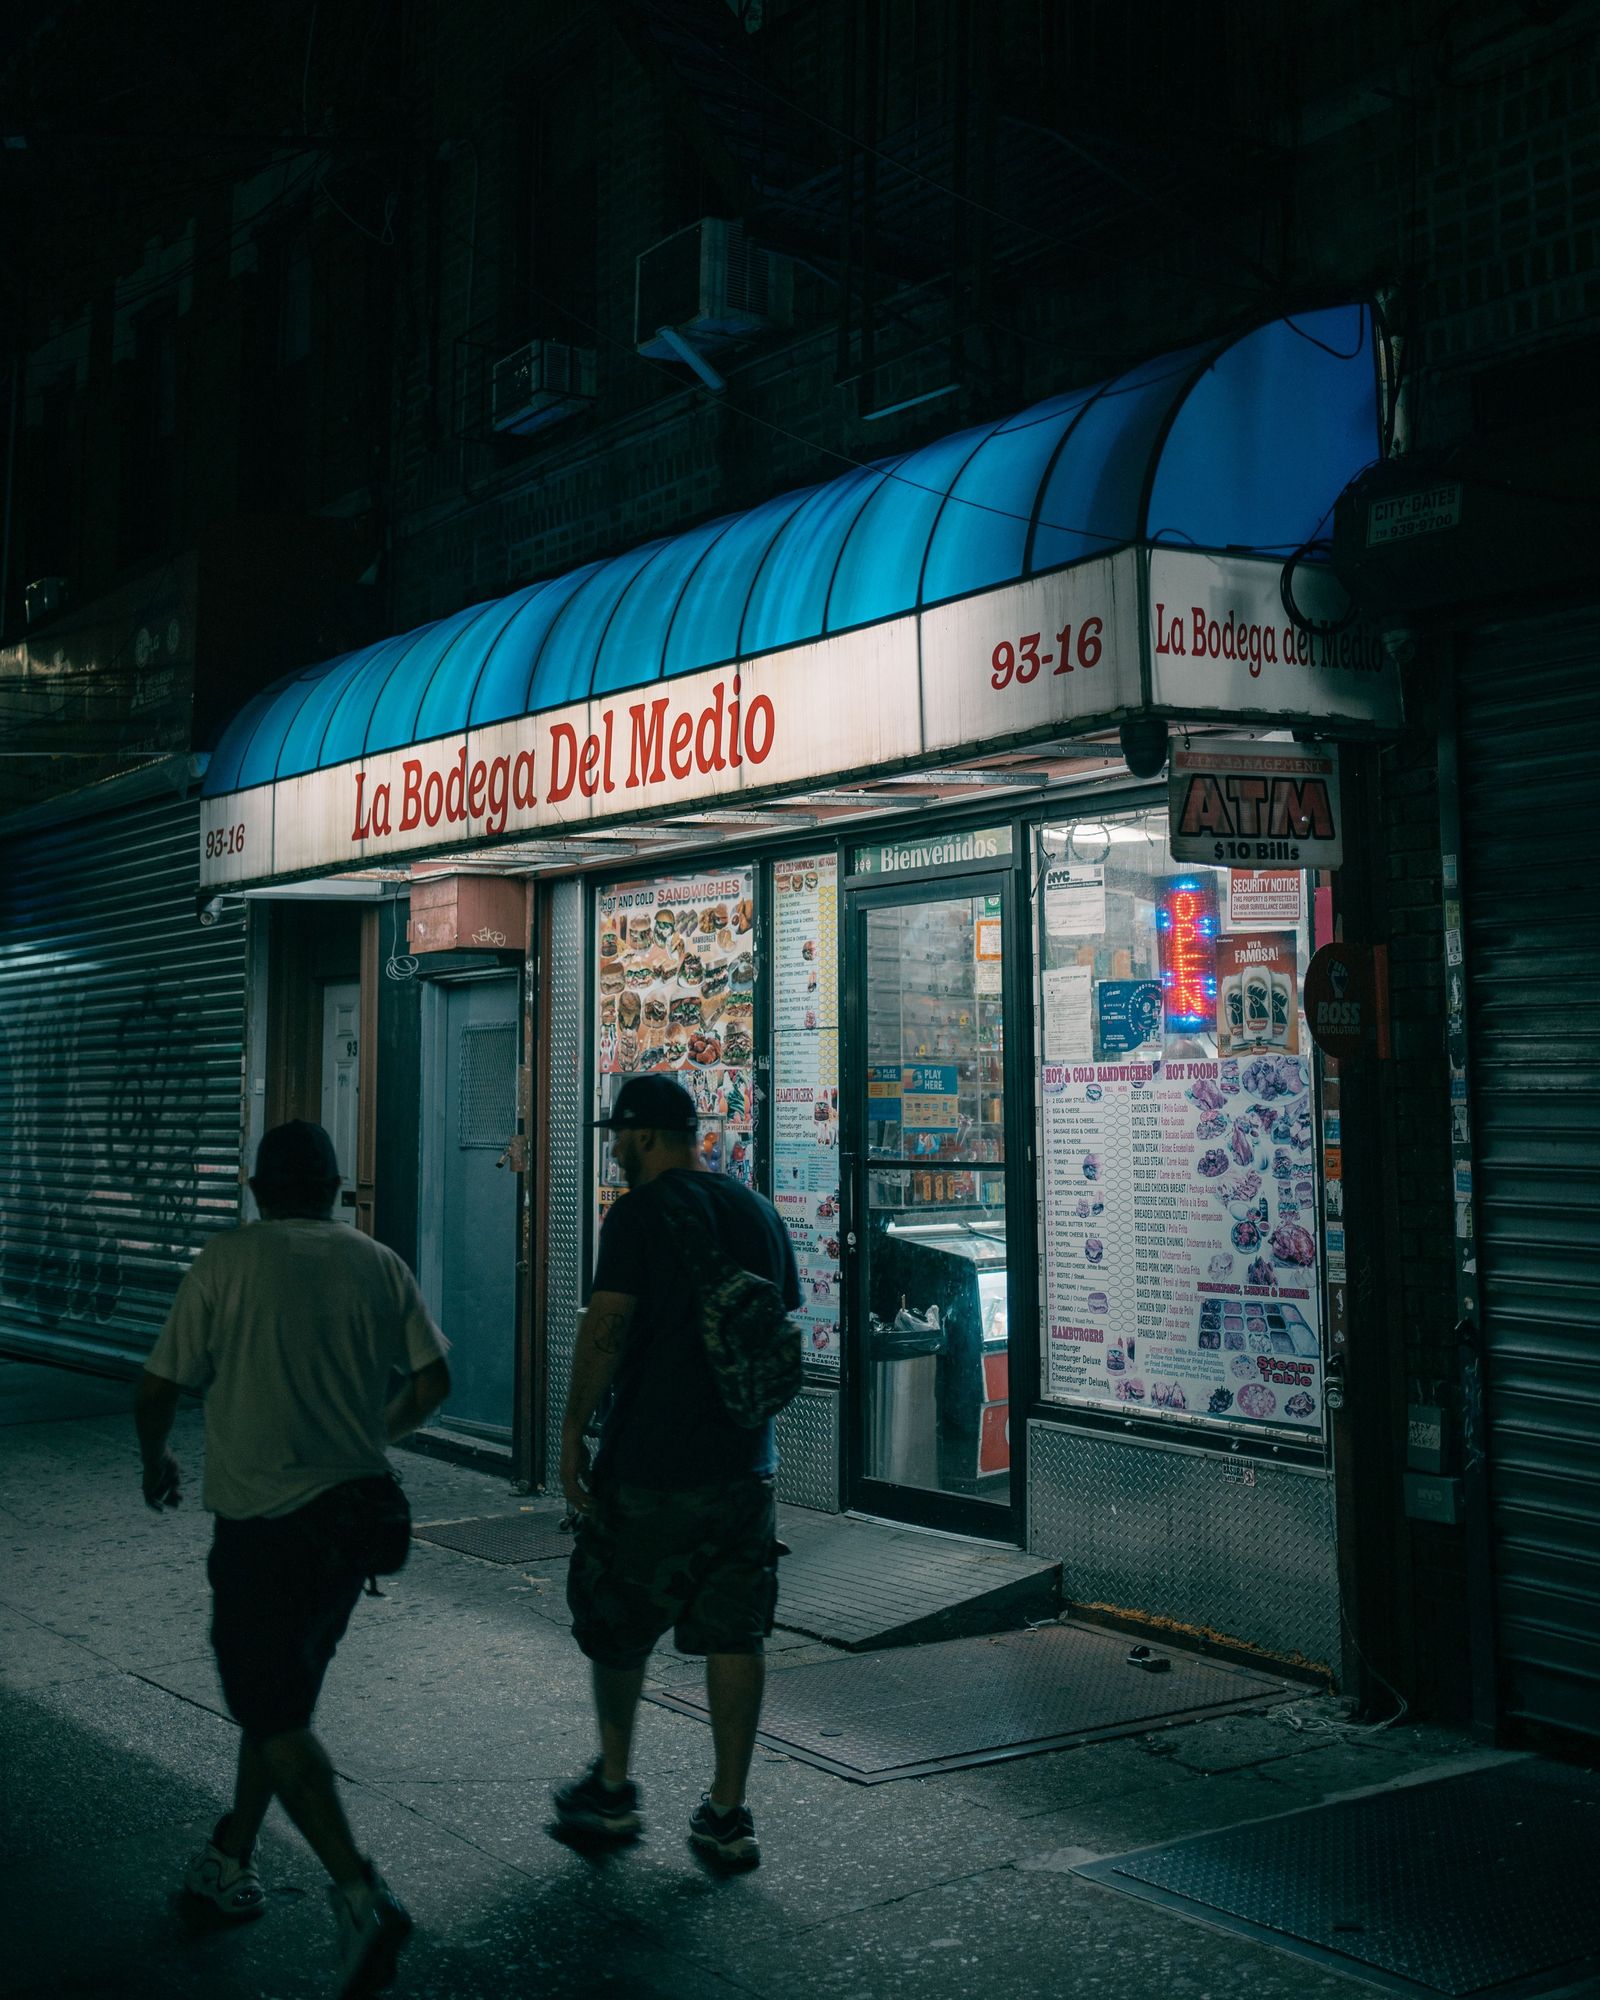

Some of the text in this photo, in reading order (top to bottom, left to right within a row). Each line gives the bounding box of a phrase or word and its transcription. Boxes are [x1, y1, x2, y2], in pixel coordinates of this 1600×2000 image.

[1156, 603, 1186, 656] La
[1191, 607, 1278, 678] Bodega
[1319, 619, 1384, 672] Medio
[991, 617, 1103, 690] 93-16
[352, 675, 777, 842] La Bodega Del Medio
[1178, 773, 1336, 841] ATM
[205, 824, 246, 860] 93-16
[880, 835, 998, 873] Bienvenidos
[1214, 841, 1300, 861] $10 Bills
[1048, 870, 1070, 884] NYC
[1233, 877, 1299, 892] SECURITY NOTICE
[602, 879, 741, 910] HOT AND COLD SANDWICHES
[1243, 895, 1263, 903] PROPERTY
[692, 933, 716, 944] HAMBURGER
[1247, 940, 1262, 949] VIVA
[1175, 892, 1203, 1015] OPEN
[1235, 946, 1279, 964] FAMOSA!
[1317, 1001, 1361, 1024] BOSS
[1317, 1024, 1361, 1034] REVOLUTION
[346, 1041, 358, 1056] 93
[924, 1069, 942, 1079] PLAY
[1046, 1065, 1152, 1083] HOT & COLD SANDWICHES
[1166, 1063, 1218, 1080] HOT FOODS
[924, 1080, 945, 1090] HERE.
[776, 1088, 814, 1103] HAMBURGERS
[1131, 1091, 1153, 1100] BEEF STEW
[777, 1106, 798, 1114] Hamburger
[1132, 1104, 1161, 1113] CHICKEN STEW
[776, 1113, 813, 1123] Hamburger Deluxe
[1146, 1117, 1158, 1126] STEW
[776, 1122, 802, 1131] Cheeseburger
[776, 1130, 803, 1139] Cheeseburger
[1140, 1130, 1150, 1139] FISH
[1151, 1130, 1162, 1139] STEW
[1146, 1143, 1158, 1152] STEAK
[1133, 1156, 1163, 1165] GRILLED STEAK
[1134, 1170, 1157, 1179] FRIED BEEF
[1134, 1183, 1186, 1193] GRILLED CHICKEN BREAST
[601, 1190, 620, 1201] BEEF
[775, 1195, 797, 1203] COMBO
[1134, 1196, 1176, 1206] ROTISSERIE CHICKEN
[1134, 1209, 1188, 1220] BREADED CHICKEN CUTLET
[790, 1222, 814, 1230] BRASA
[1135, 1222, 1165, 1232] FRIED CHICKEN
[1135, 1235, 1184, 1246] FRIED CHICKEN CHUNKS
[1135, 1249, 1159, 1259] FRIED PORK
[1136, 1262, 1173, 1273] FRIED PORK CHOPS
[1136, 1275, 1160, 1286] ROAST PORK
[1136, 1288, 1172, 1300] BAKED PORK RIBS
[1137, 1302, 1166, 1313] CHICKEN SOUP
[1151, 1316, 1162, 1326] SOUP
[1052, 1325, 1104, 1343] HAMBURGERS
[1137, 1328, 1167, 1340] SPANISH SOUP
[1052, 1342, 1080, 1353] Hamburger
[811, 1357, 839, 1366] OCASION
[818, 1353, 841, 1361] BUFFET
[1052, 1352, 1101, 1366] Hamburger Deluxe
[1052, 1362, 1087, 1375] Cheeseburger
[1257, 1356, 1315, 1375] Steam
[1052, 1372, 1087, 1386] Cheeseburger
[1260, 1369, 1312, 1387] Table
